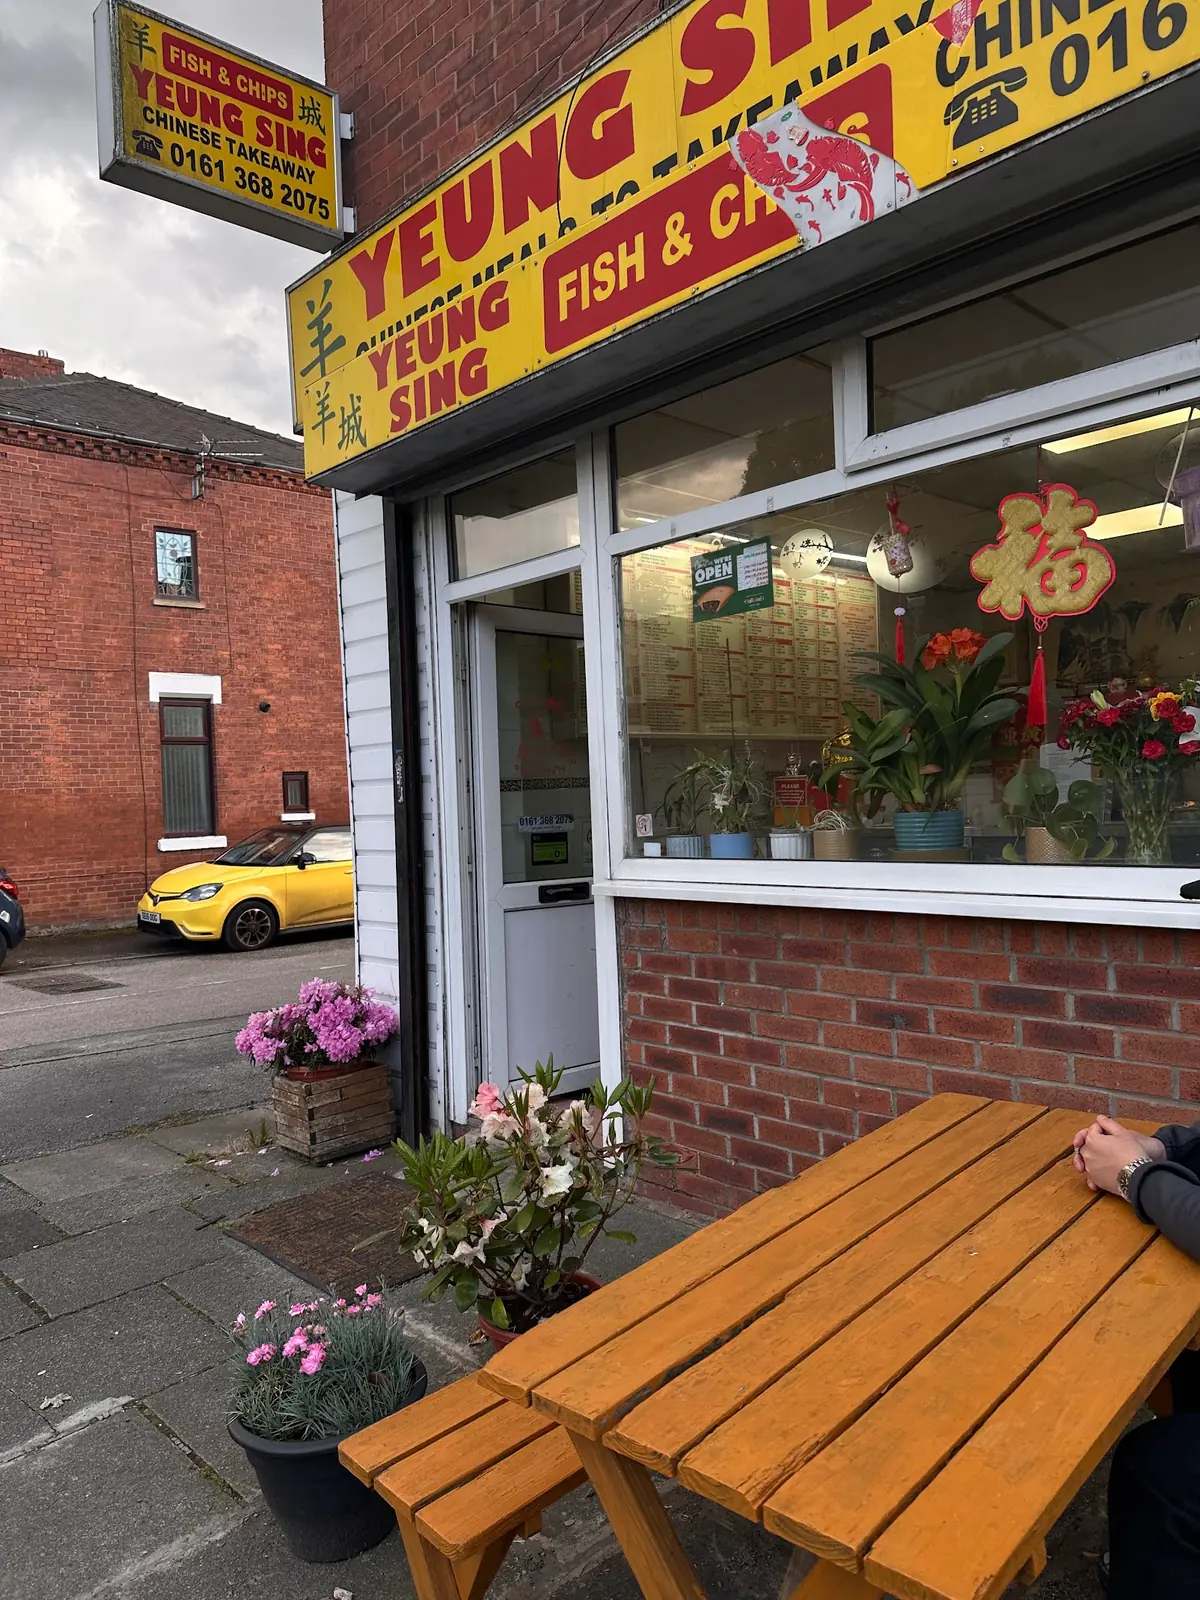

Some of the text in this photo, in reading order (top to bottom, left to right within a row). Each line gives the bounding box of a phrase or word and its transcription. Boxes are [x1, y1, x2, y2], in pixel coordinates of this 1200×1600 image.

[126, 20, 157, 62] 羊
[170, 46, 289, 110] FISH & CHIPS
[936, 0, 1117, 88] CHIN
[1050, 0, 1188, 97] 016
[128, 62, 327, 169] YEUNG SING
[142, 105, 316, 185] CHINESE TAKEAWAY
[298, 96, 326, 136] 城
[170, 143, 330, 221] 0161 368 2075
[347, 69, 635, 322] YEUNG
[557, 232, 646, 322] FISH
[661, 211, 694, 266] &
[300, 279, 347, 378] 羊
[368, 280, 510, 391] YEUNG
[389, 347, 488, 433] SING
[695, 561, 733, 583] OPEN
